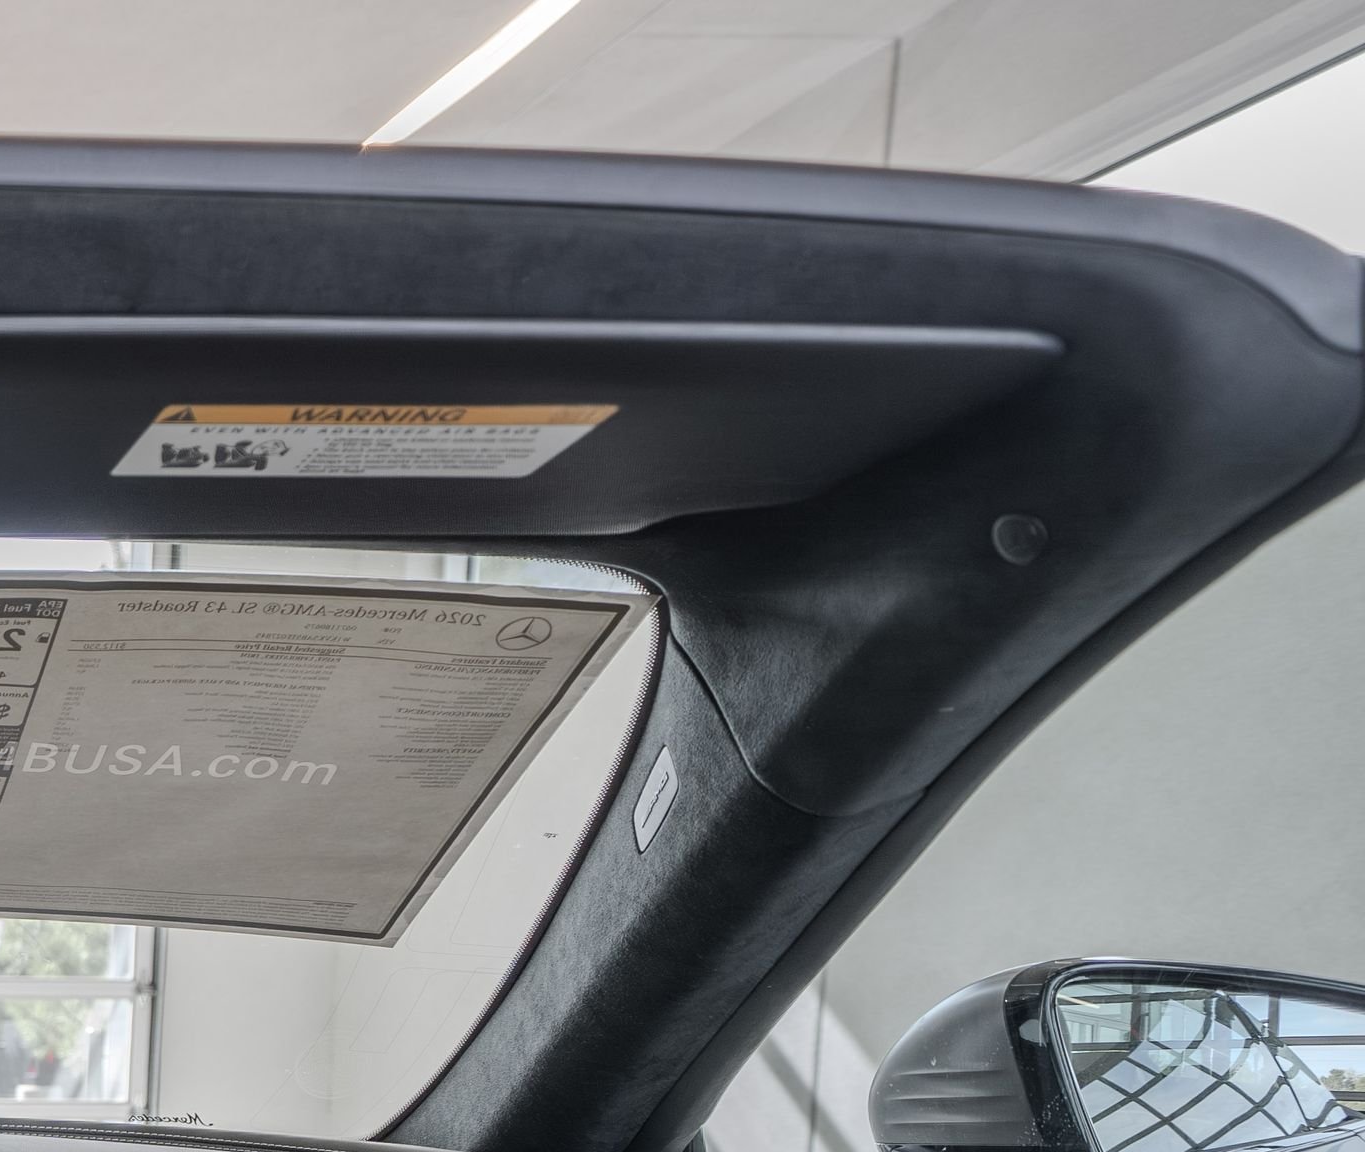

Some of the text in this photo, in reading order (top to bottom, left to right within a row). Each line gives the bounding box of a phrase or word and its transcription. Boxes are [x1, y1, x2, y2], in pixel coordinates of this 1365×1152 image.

[289, 407, 468, 422] WARNING
[255, 426, 307, 434] WITH
[316, 427, 430, 435] ADVANCED
[440, 427, 477, 435] AIR
